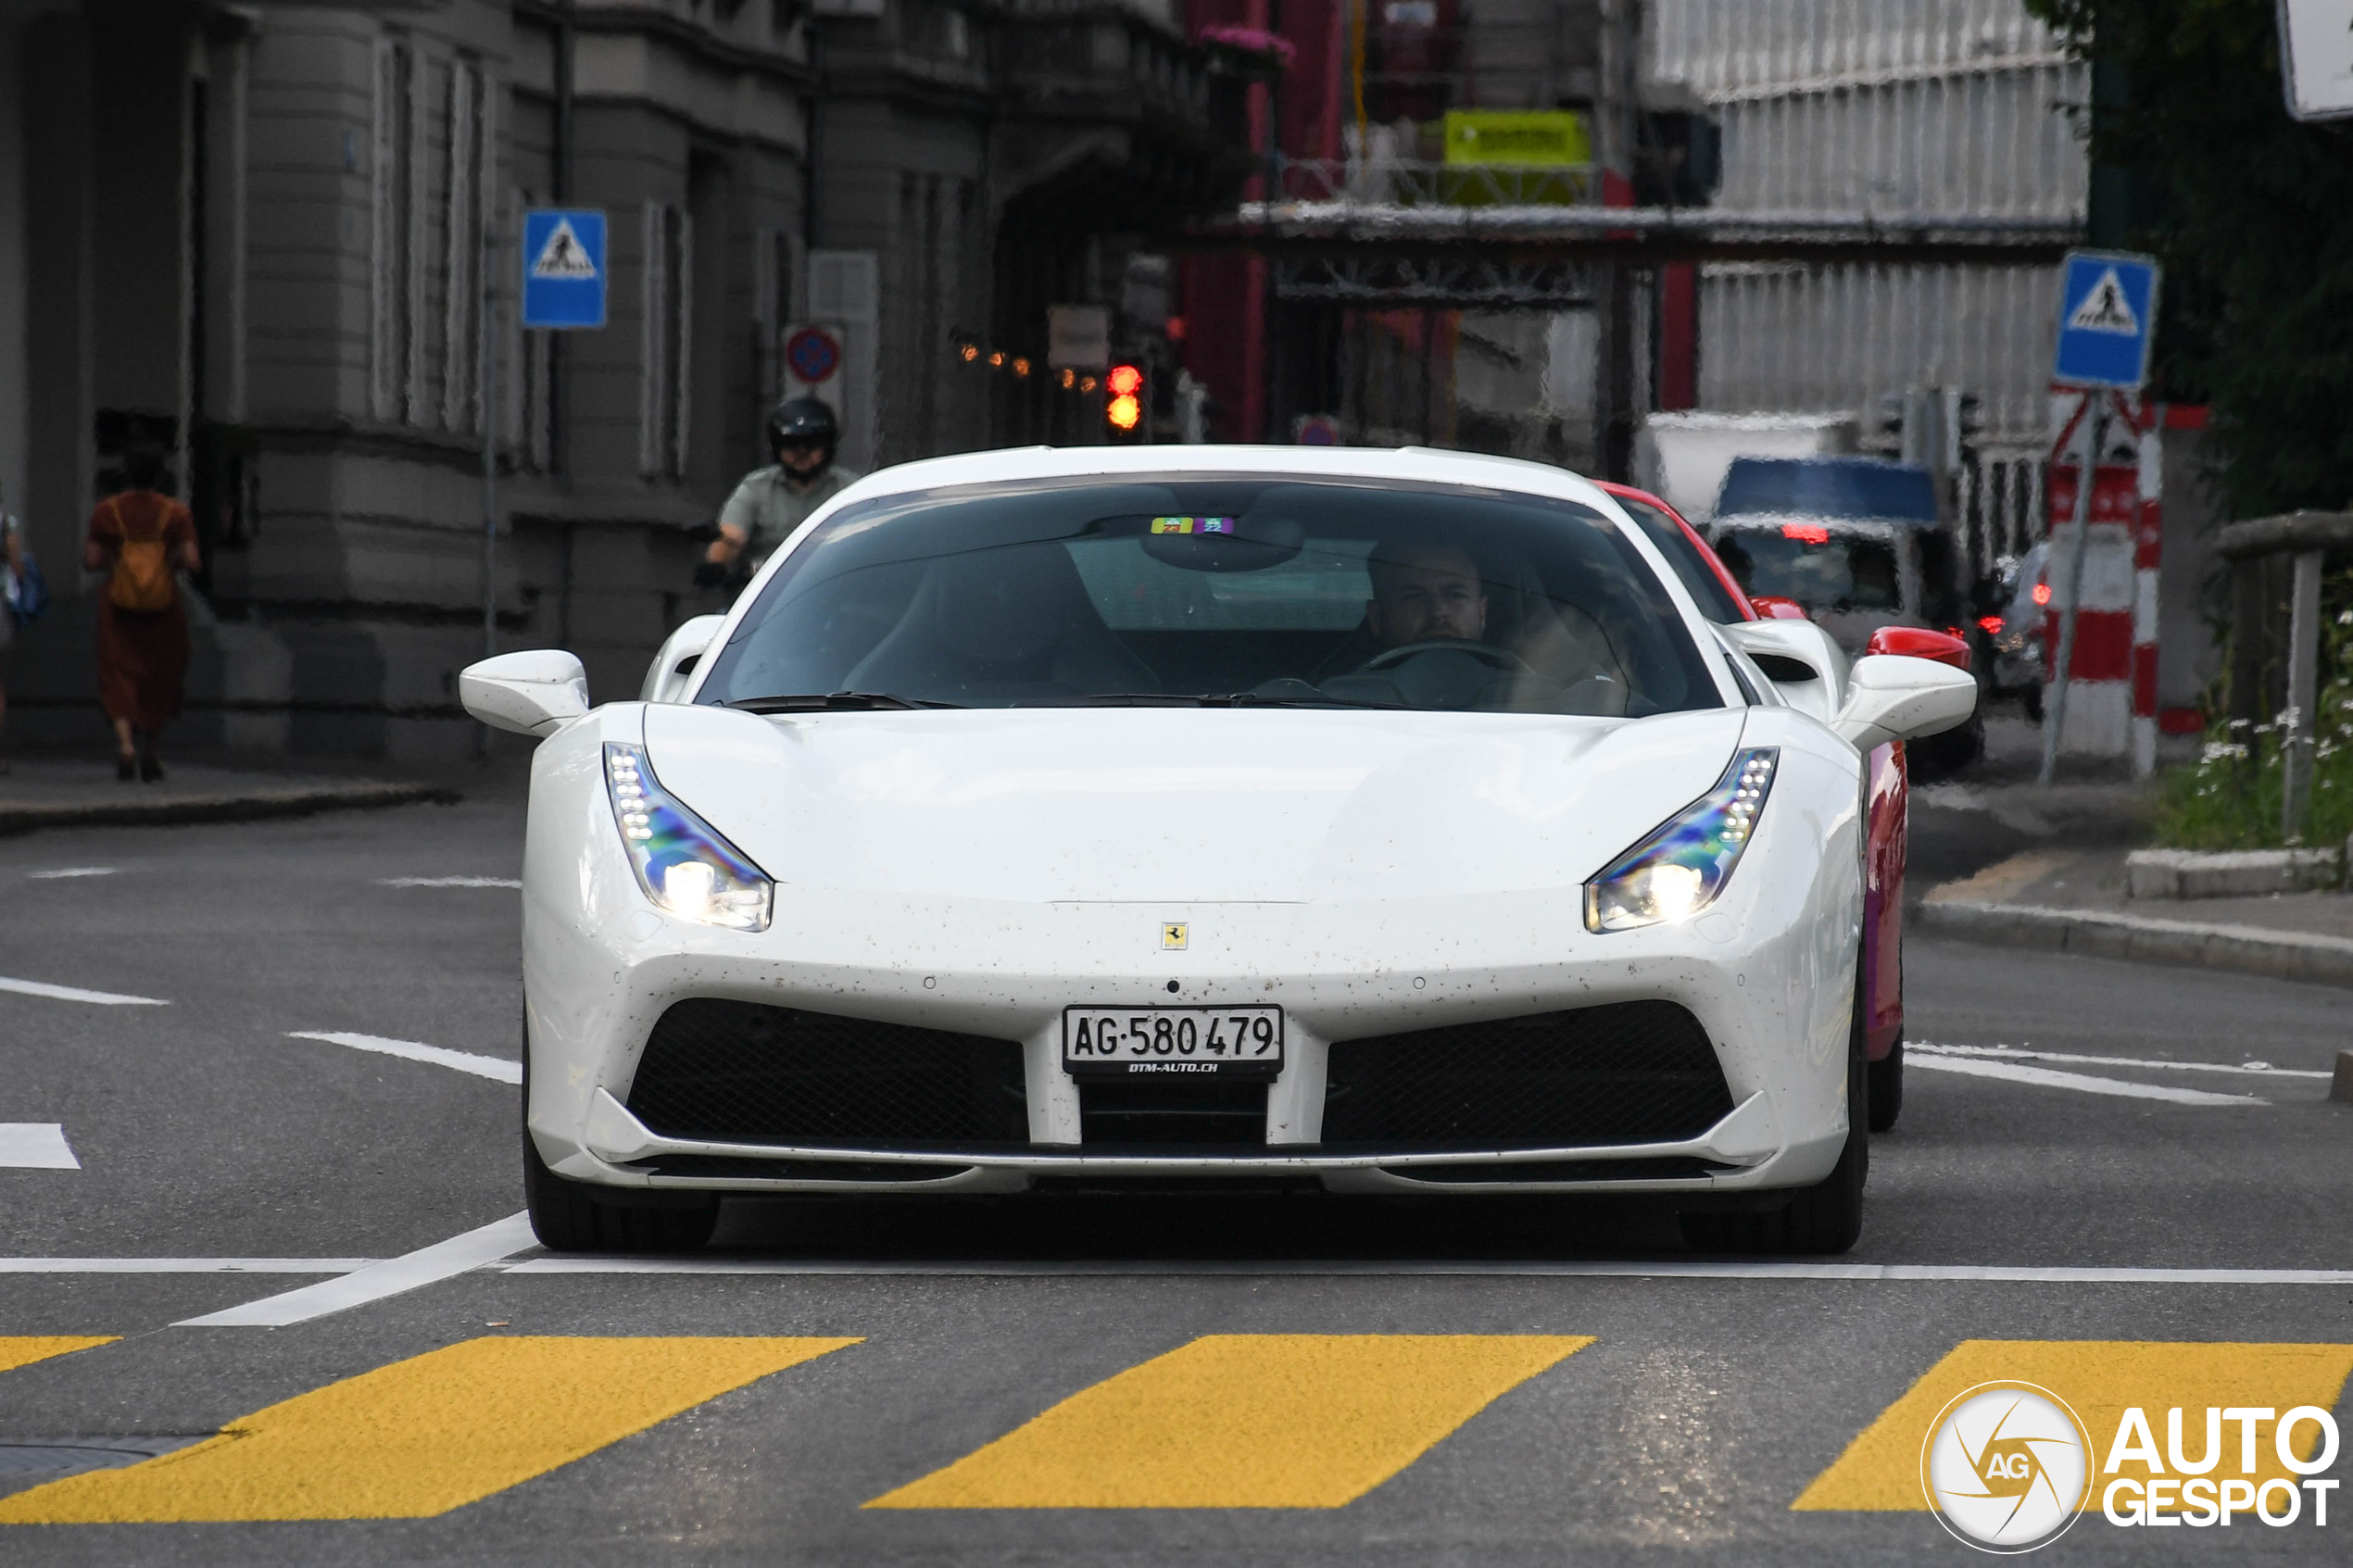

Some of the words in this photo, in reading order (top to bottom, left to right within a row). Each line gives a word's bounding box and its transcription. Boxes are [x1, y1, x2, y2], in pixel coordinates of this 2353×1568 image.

[1203, 524, 1222, 533] 22
[1206, 1016, 1274, 1055] 479
[1128, 1063, 1218, 1073] DTM-AUTO.CH
